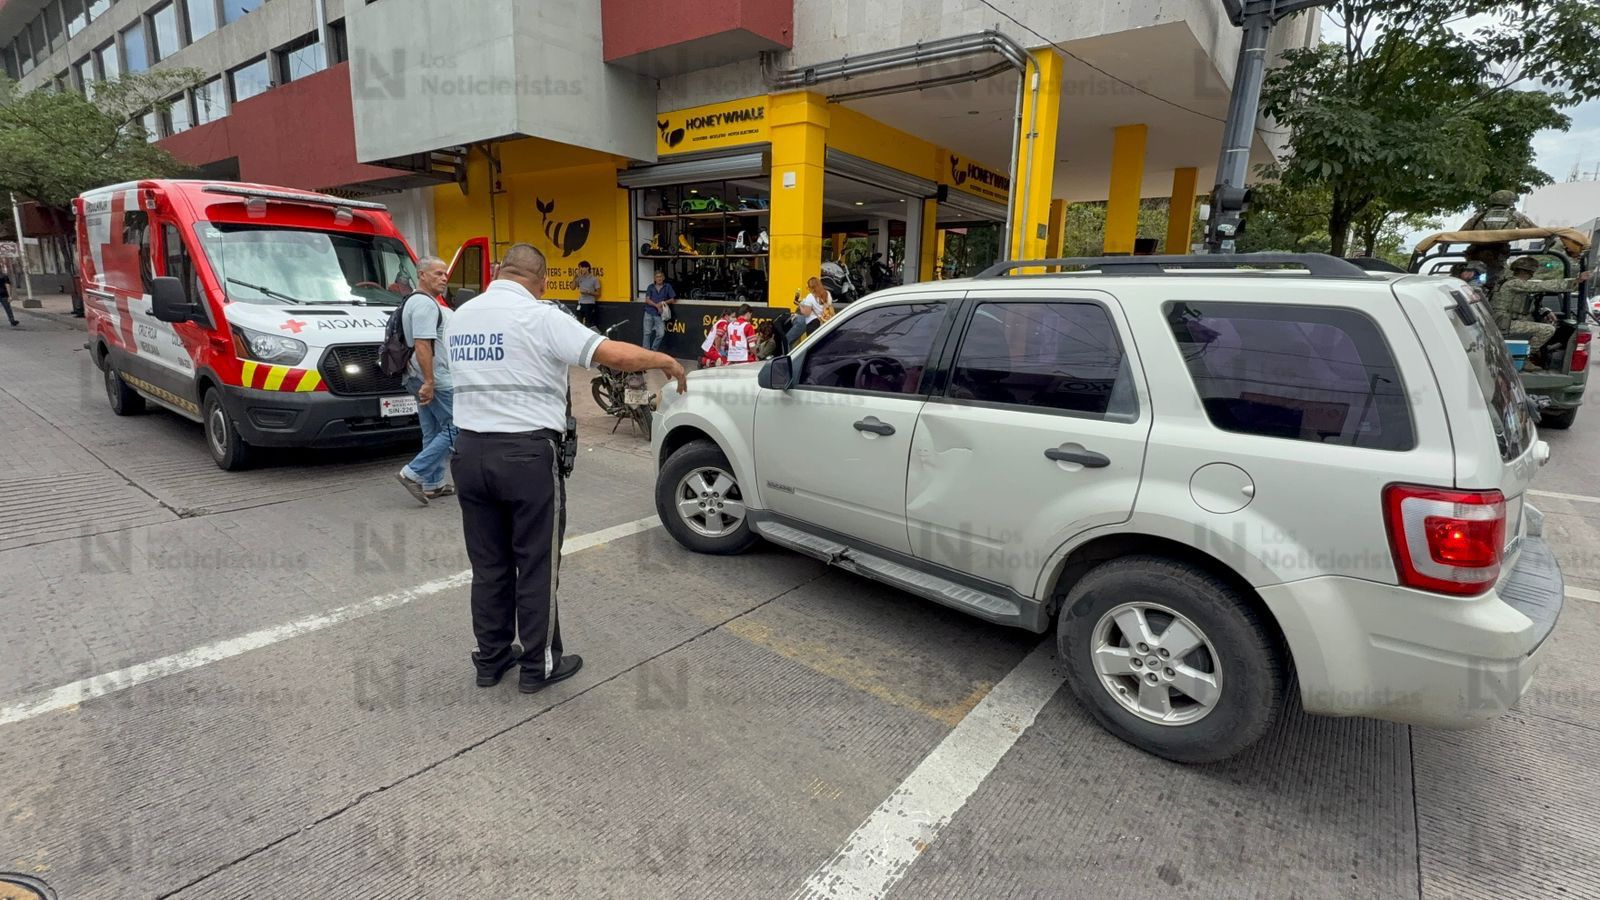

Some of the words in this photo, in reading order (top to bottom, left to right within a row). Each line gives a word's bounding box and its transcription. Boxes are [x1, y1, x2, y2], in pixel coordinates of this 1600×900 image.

[686, 113, 722, 131] HONEY
[722, 106, 764, 125] WHALE
[449, 334, 485, 347] UNIDAD
[490, 333, 504, 345] DE
[450, 347, 505, 362] VIALIDAD
